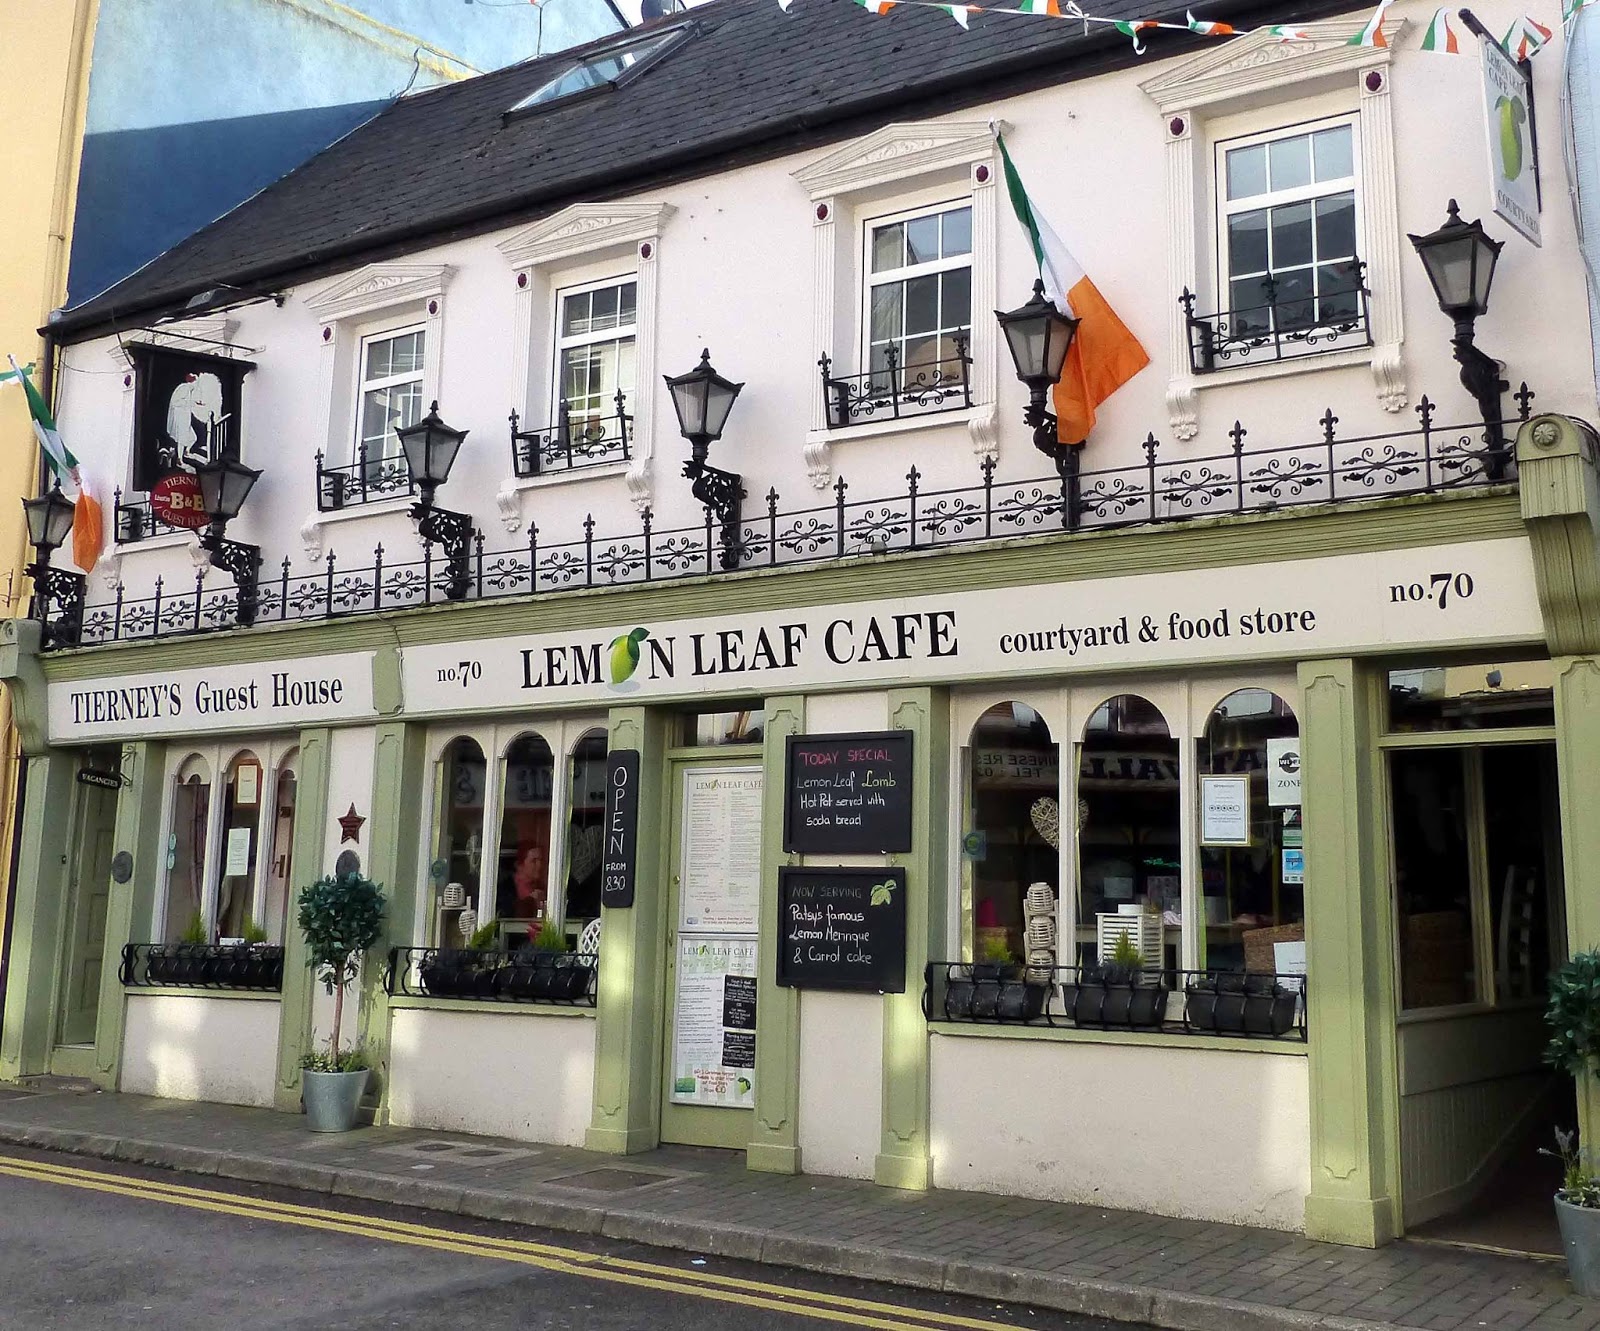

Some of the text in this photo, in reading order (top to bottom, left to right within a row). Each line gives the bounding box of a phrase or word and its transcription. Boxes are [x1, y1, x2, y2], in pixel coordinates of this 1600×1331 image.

[999, 606, 1317, 656] courtyard & food store
[689, 623, 808, 676] LEAF
[824, 610, 958, 665] CAFE
[70, 672, 344, 724] TIERNEY'S Guest House
[799, 748, 893, 767] TODAY SPECIAL
[797, 776, 832, 789] Lemon
[832, 770, 856, 793] Leaf
[800, 791, 886, 809] Hot Pot served with
[610, 766, 628, 855] OPEN
[806, 812, 862, 826] soda bread
[605, 862, 627, 872] FROM
[791, 885, 862, 899] NOW SERVING
[788, 903, 865, 928] Patsy's famous
[788, 923, 823, 941] Lemon
[793, 945, 872, 965] & Carrot cake
